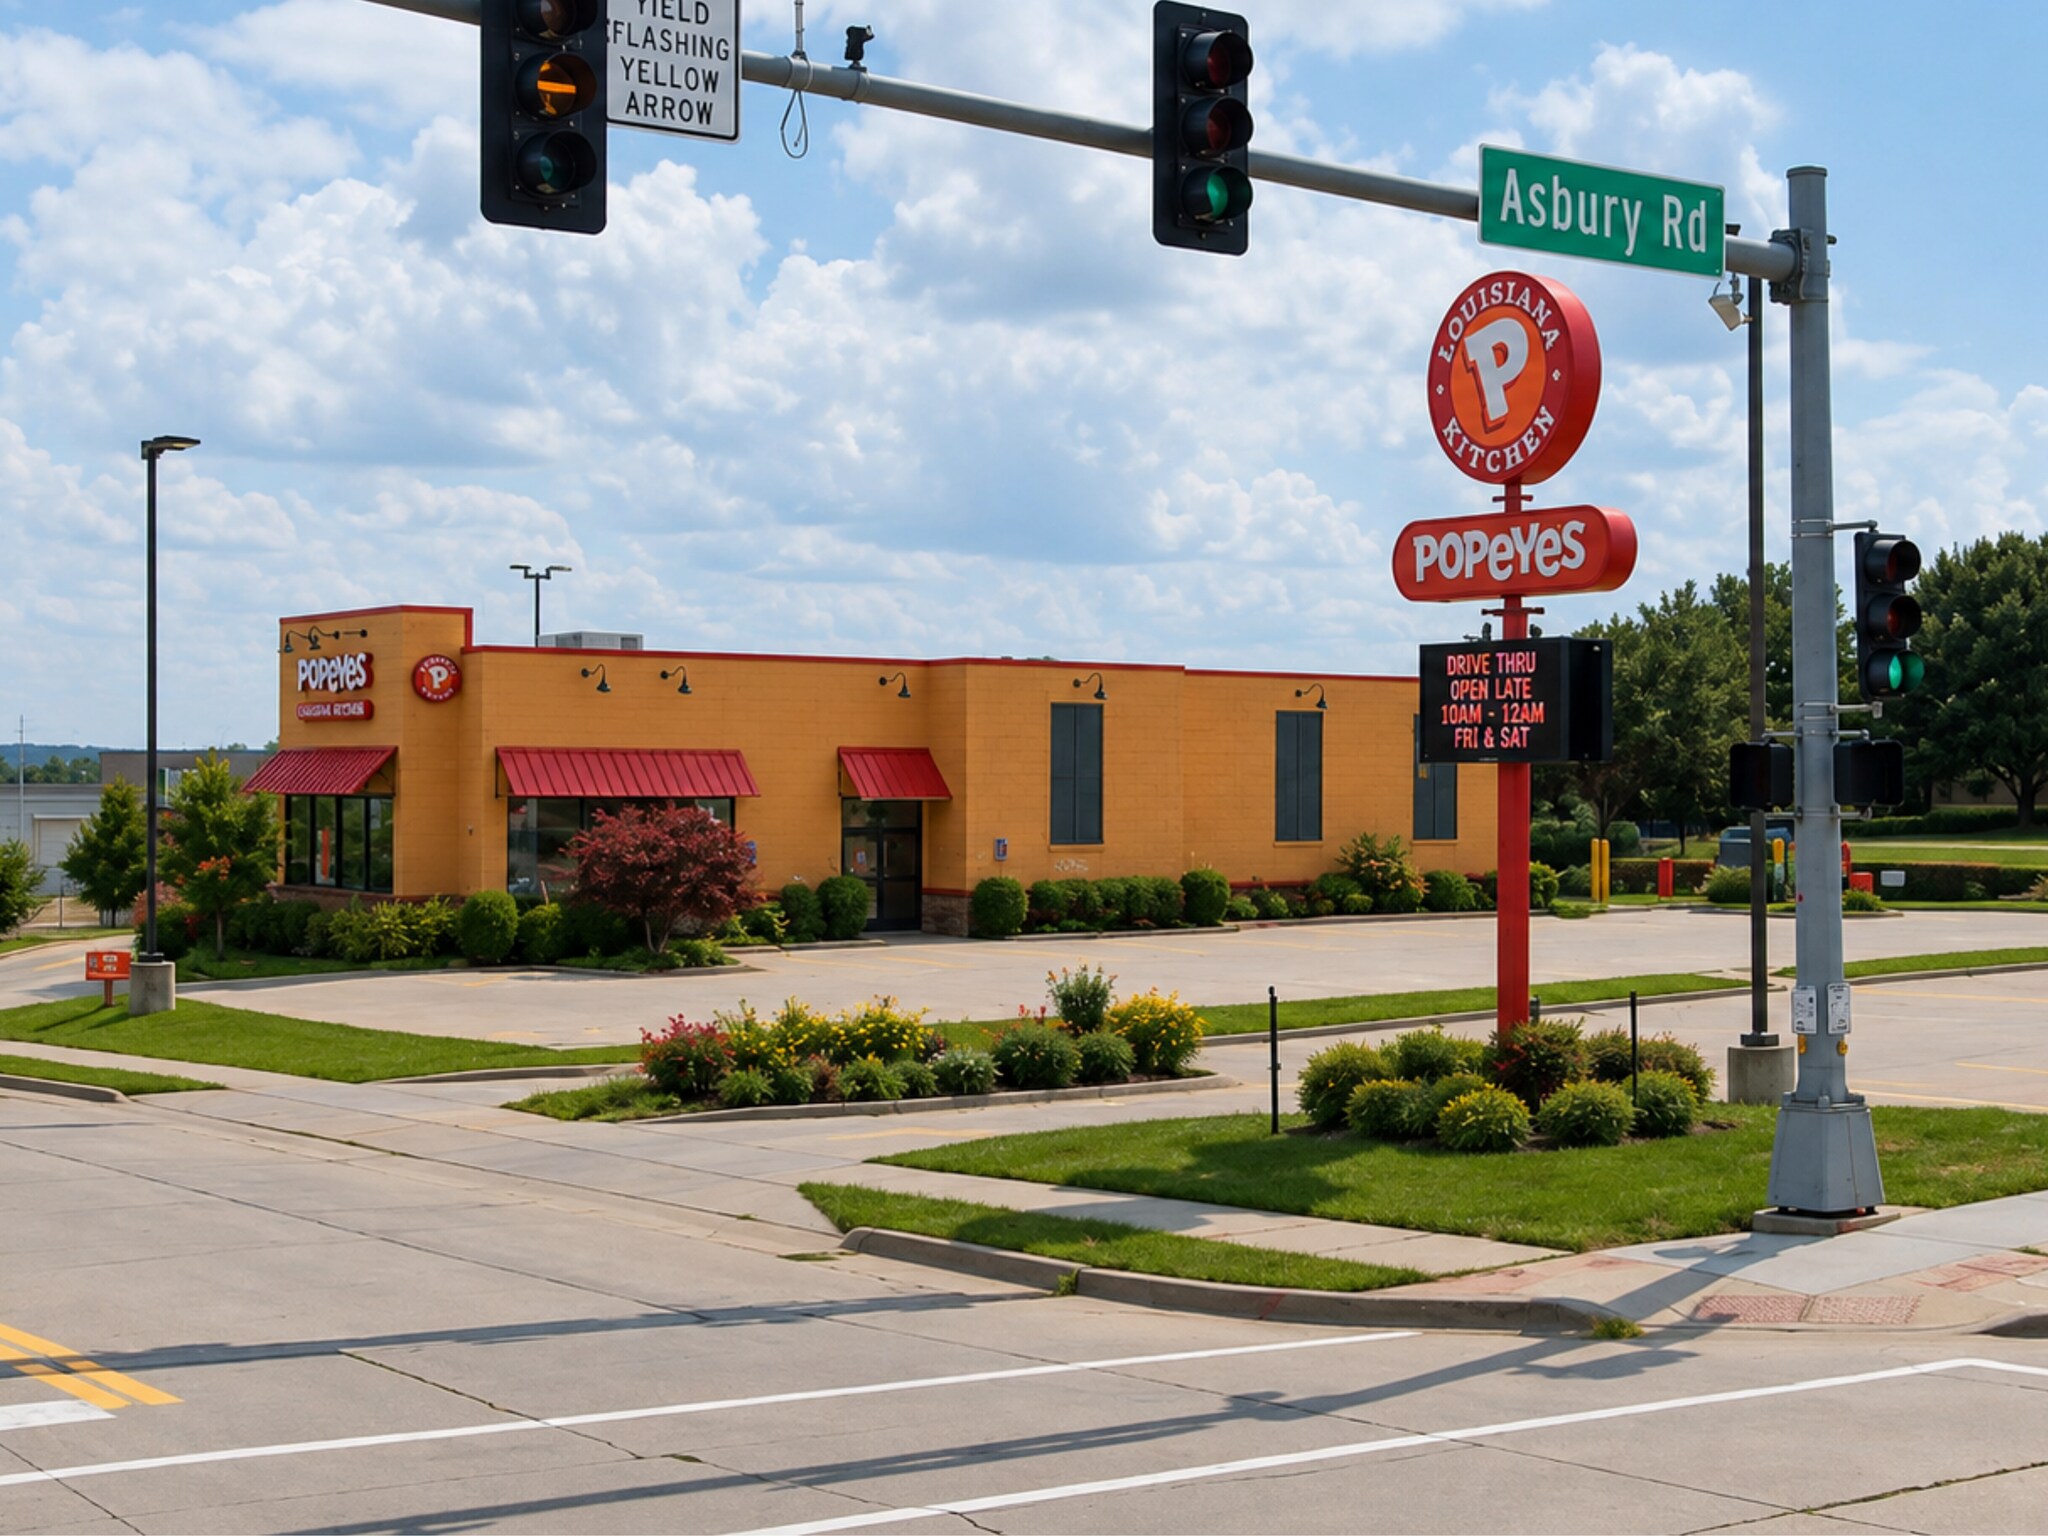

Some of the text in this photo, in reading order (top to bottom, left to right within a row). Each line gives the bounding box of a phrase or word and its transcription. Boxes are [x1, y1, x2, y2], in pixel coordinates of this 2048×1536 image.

[638, 0, 709, 24] YIELD
[613, 20, 729, 61] FLASHING
[620, 56, 719, 94] YELLOW
[625, 91, 713, 125] ARROW
[1500, 168, 1706, 257] Asbury Rd
[1438, 281, 1560, 363] LOUISIANA
[1442, 405, 1555, 473] KITCHEN
[1446, 651, 1536, 676] DRIVE THRU
[1450, 677, 1532, 701] OPEN LATE
[1441, 703, 1482, 725] 10AM
[1502, 701, 1544, 724] 12AM
[1454, 726, 1531, 749] FRI & SAT
